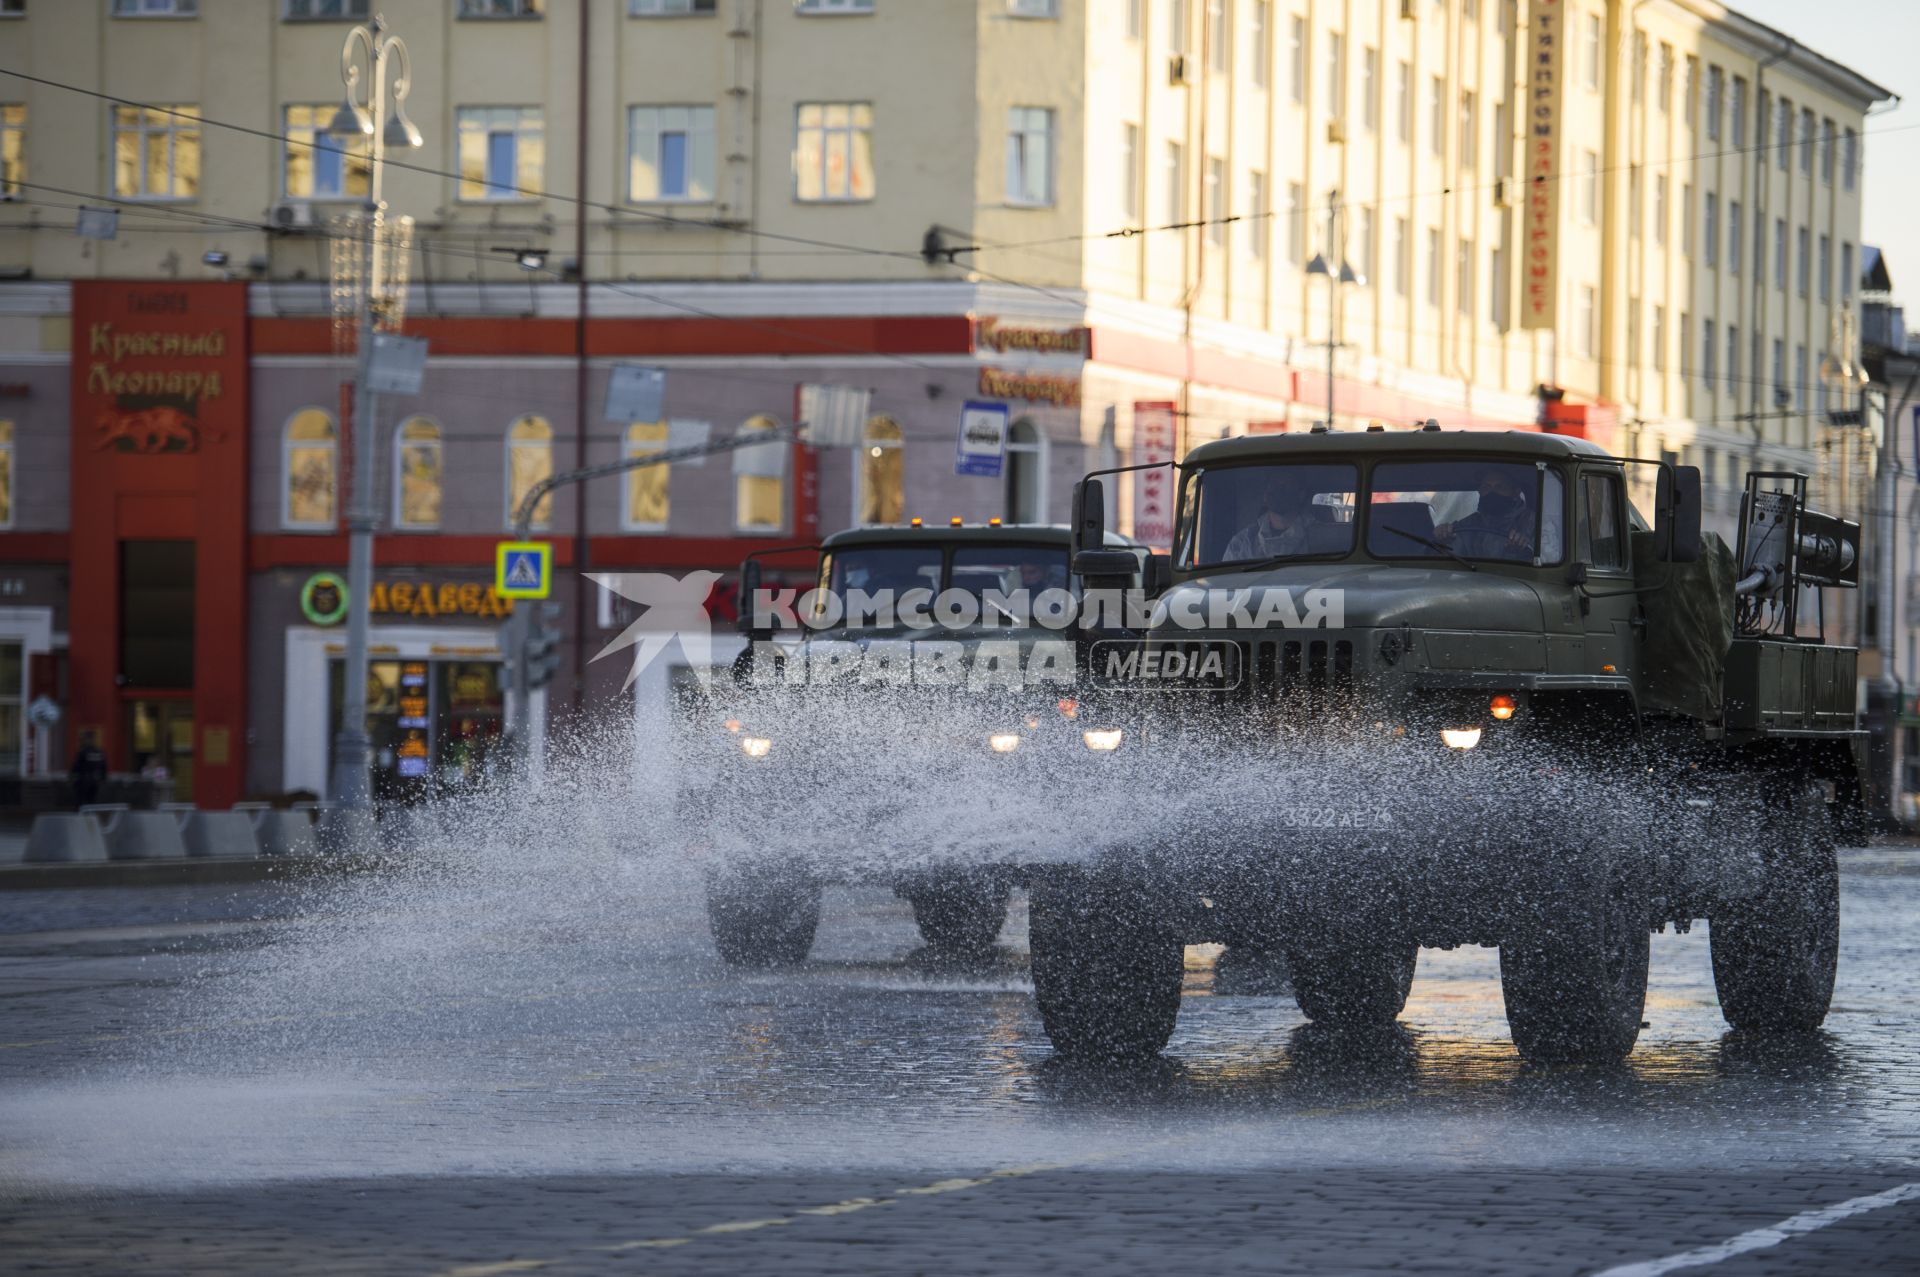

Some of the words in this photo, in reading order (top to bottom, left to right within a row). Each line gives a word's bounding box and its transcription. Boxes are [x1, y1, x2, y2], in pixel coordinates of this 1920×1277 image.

[89, 322, 224, 363] Красный
[87, 363, 222, 400] Леопард
[1283, 807, 1336, 827] 3322
